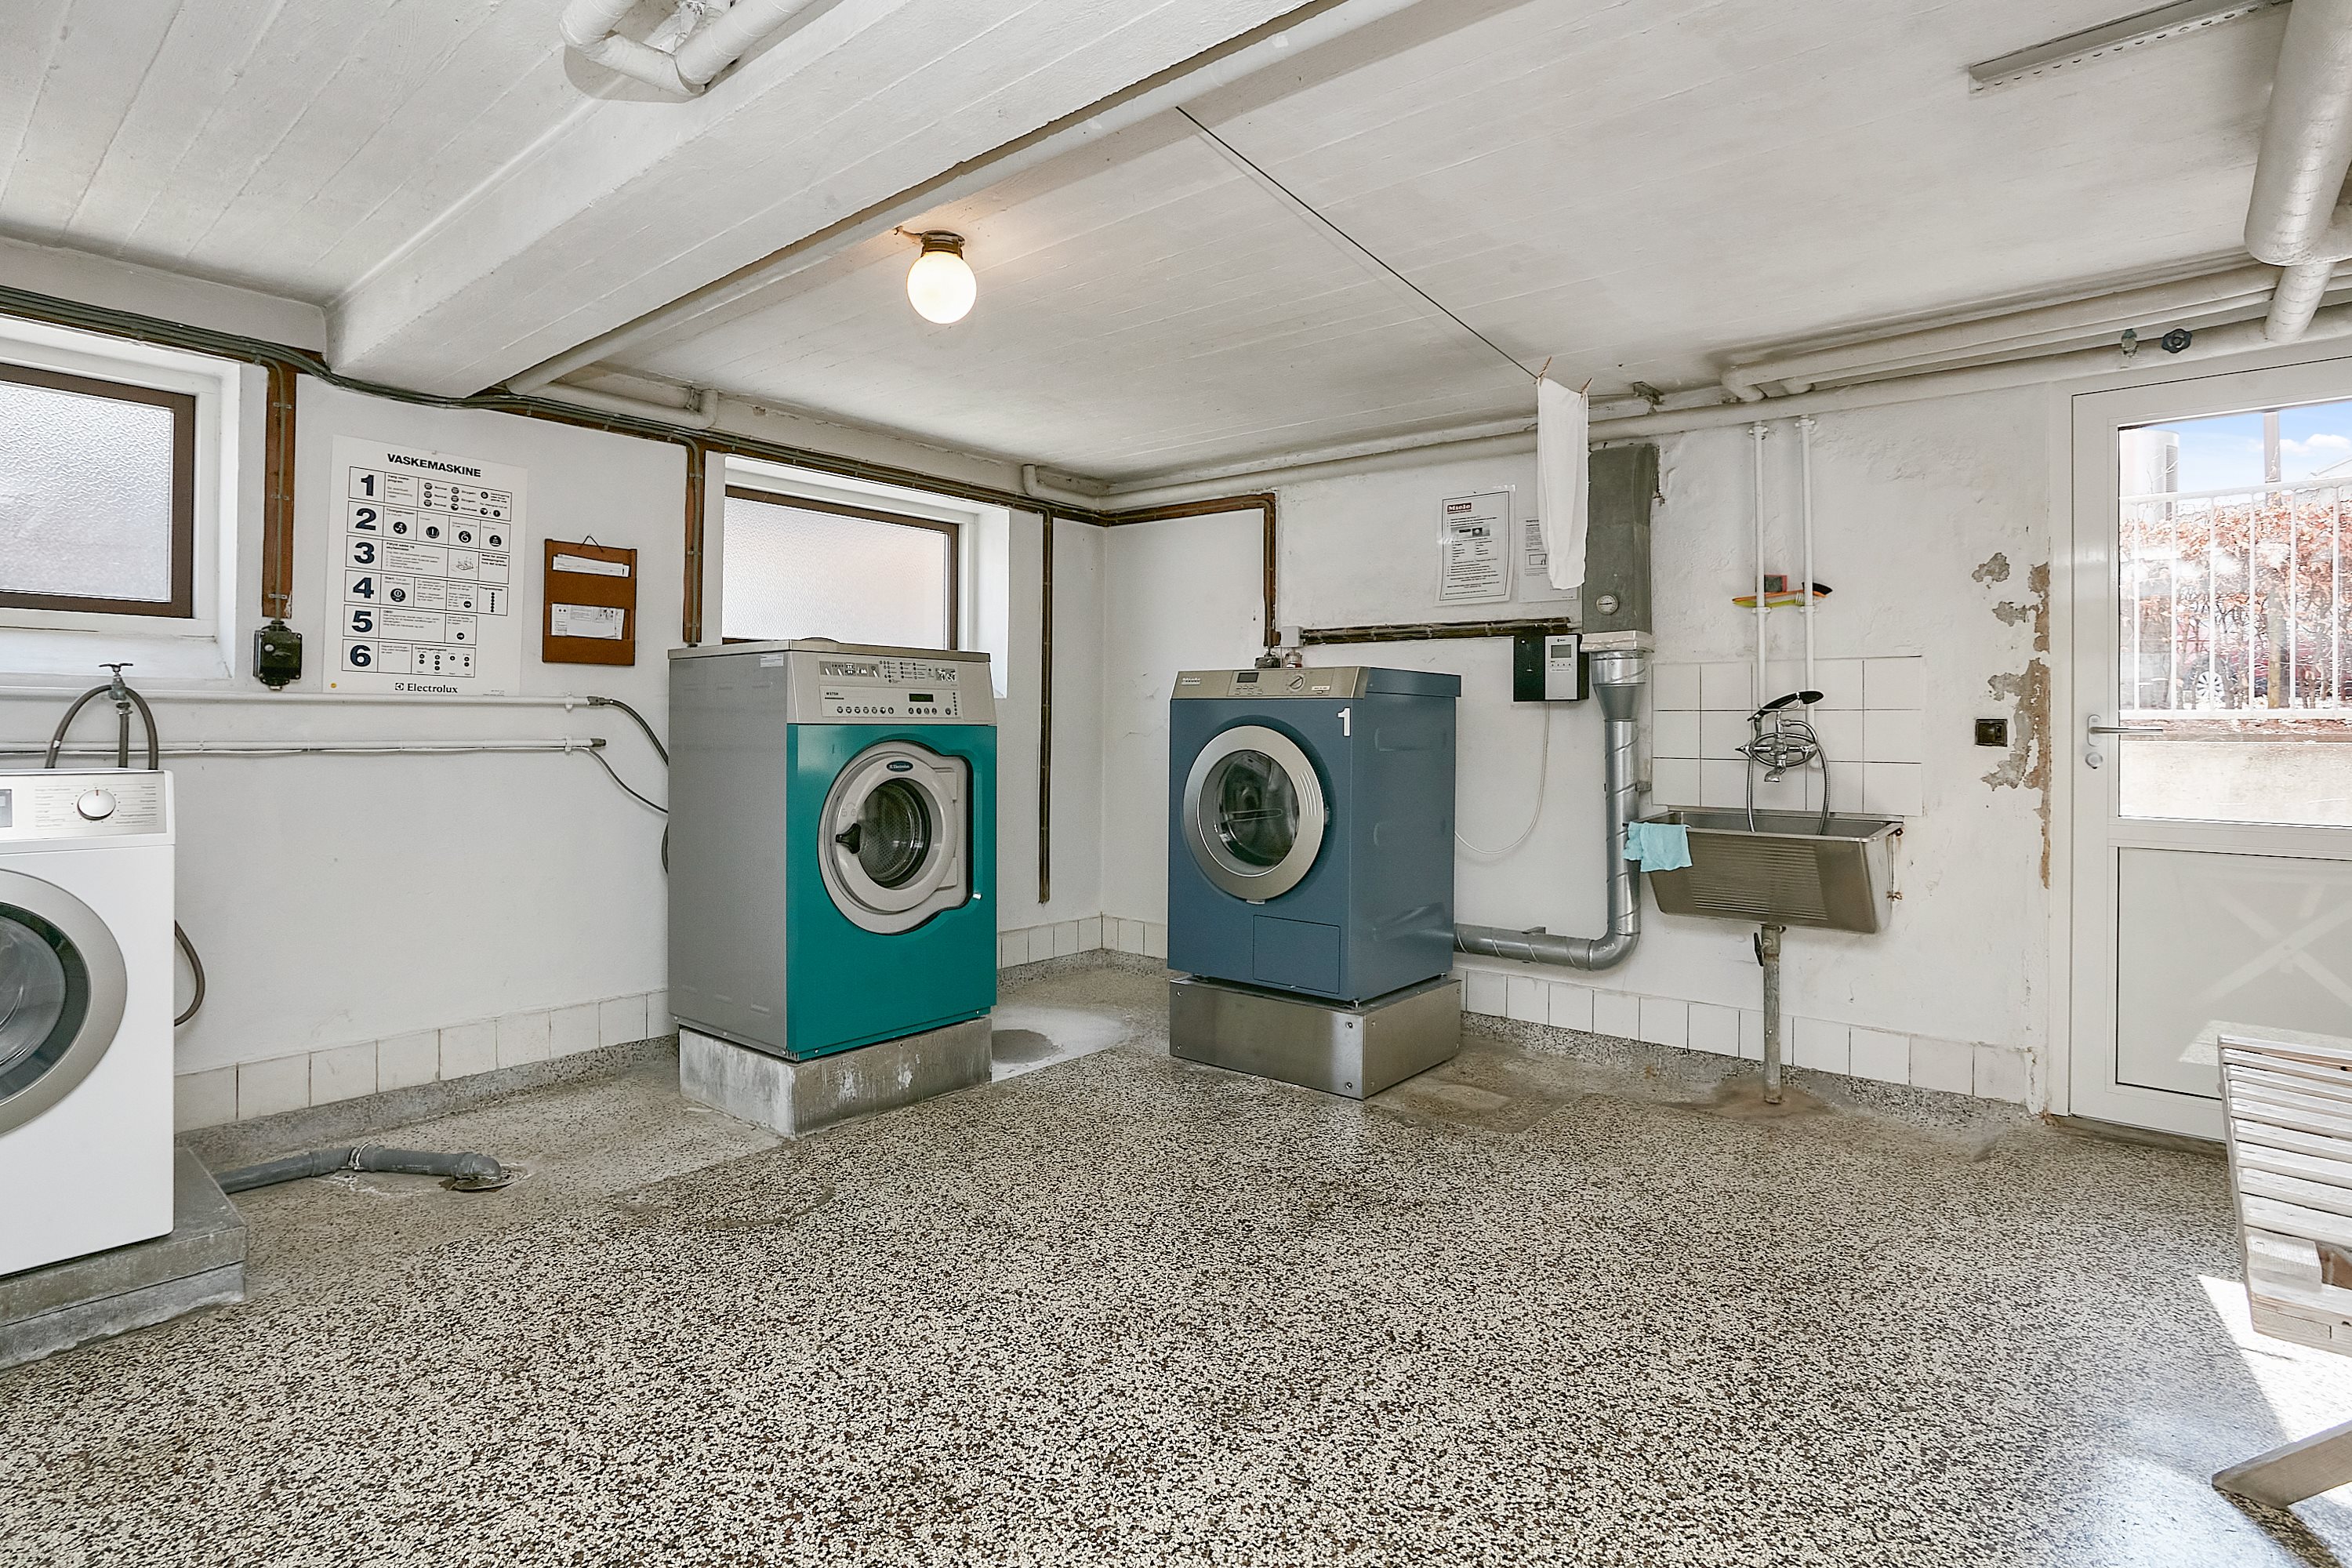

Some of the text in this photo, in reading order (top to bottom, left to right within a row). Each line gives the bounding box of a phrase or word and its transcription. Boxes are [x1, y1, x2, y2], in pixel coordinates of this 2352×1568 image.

[387, 453, 481, 477] VASKEMASKINE
[361, 474, 374, 496] 1
[355, 508, 376, 531] 2
[354, 542, 375, 564] 3
[353, 577, 374, 599] 4
[352, 610, 372, 633] 5
[350, 644, 372, 667] 6
[407, 683, 458, 693] Electrolux
[1337, 707, 1351, 736] 1
